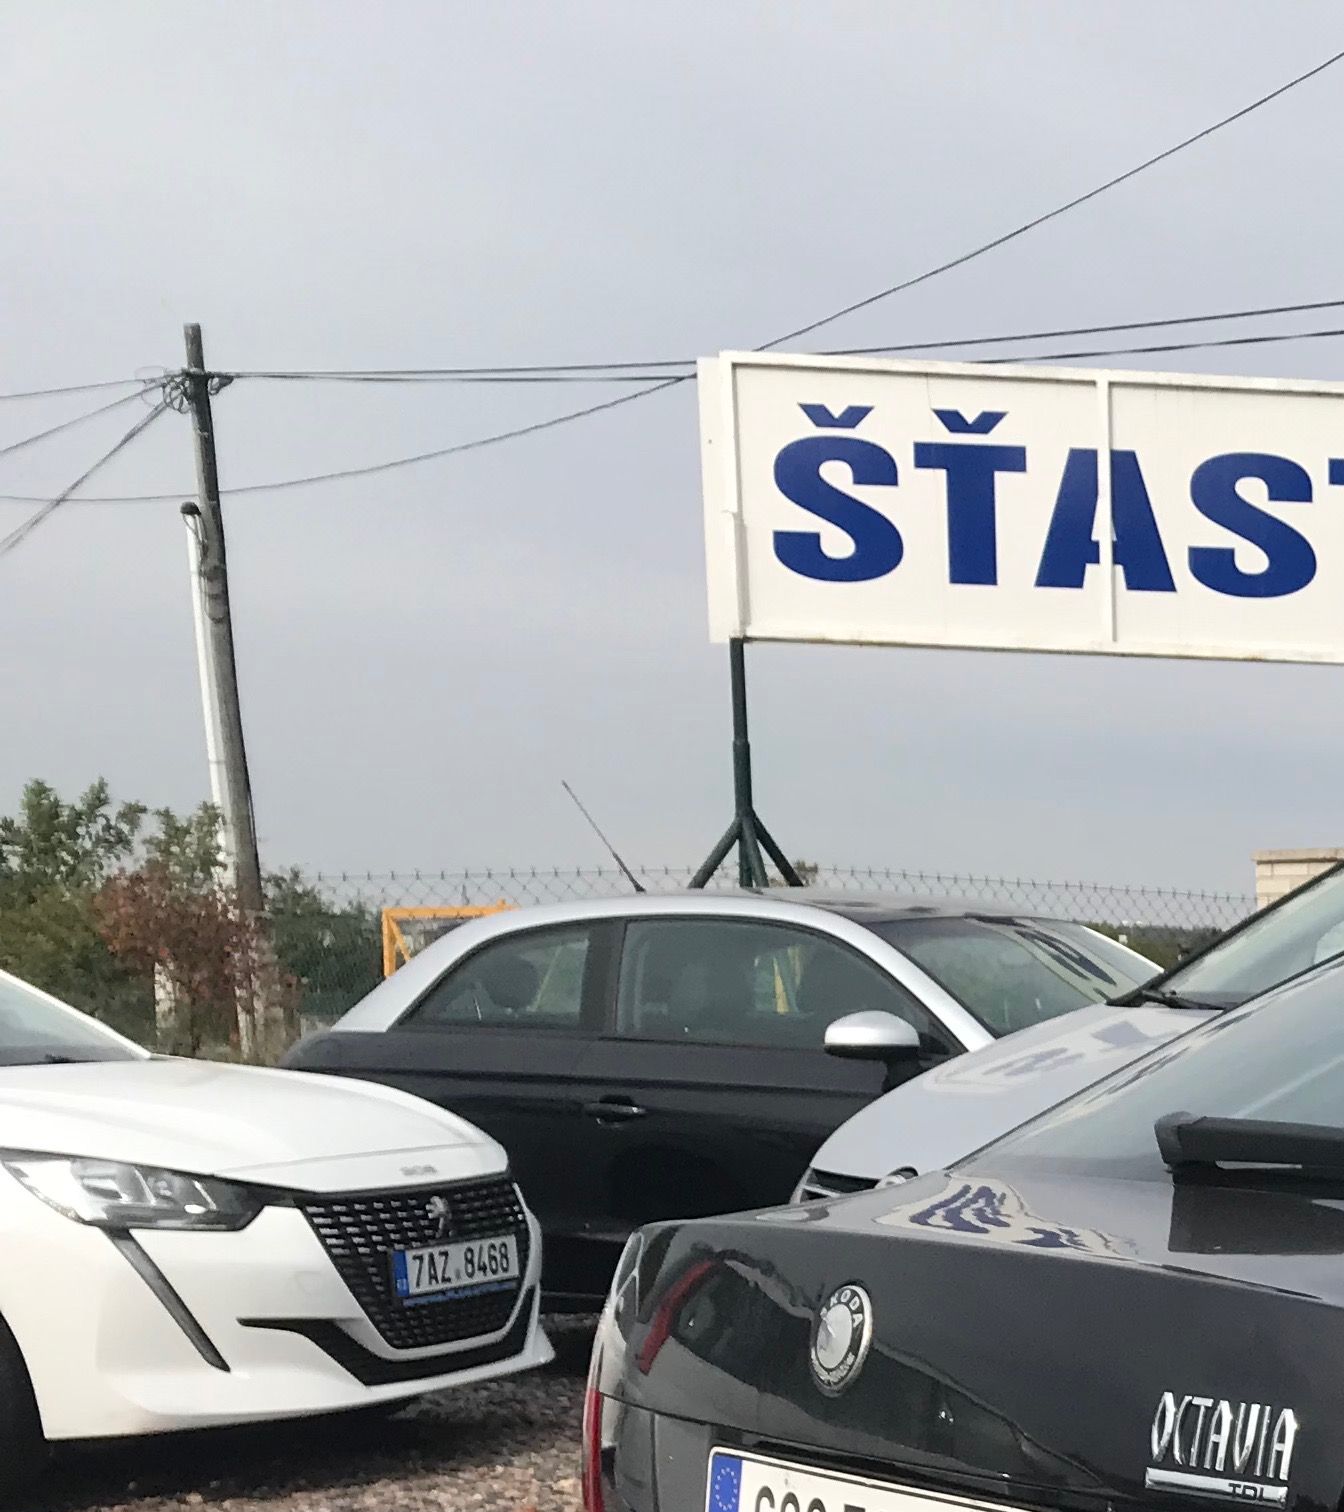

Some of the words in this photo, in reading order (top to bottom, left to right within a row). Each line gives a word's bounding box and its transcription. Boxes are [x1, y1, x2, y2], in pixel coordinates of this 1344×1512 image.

[412, 1250, 451, 1289] 7AZ
[464, 1242, 510, 1279] 8468
[1151, 1391, 1298, 1480] OCTAVIA
[1229, 1483, 1265, 1502] TDI
